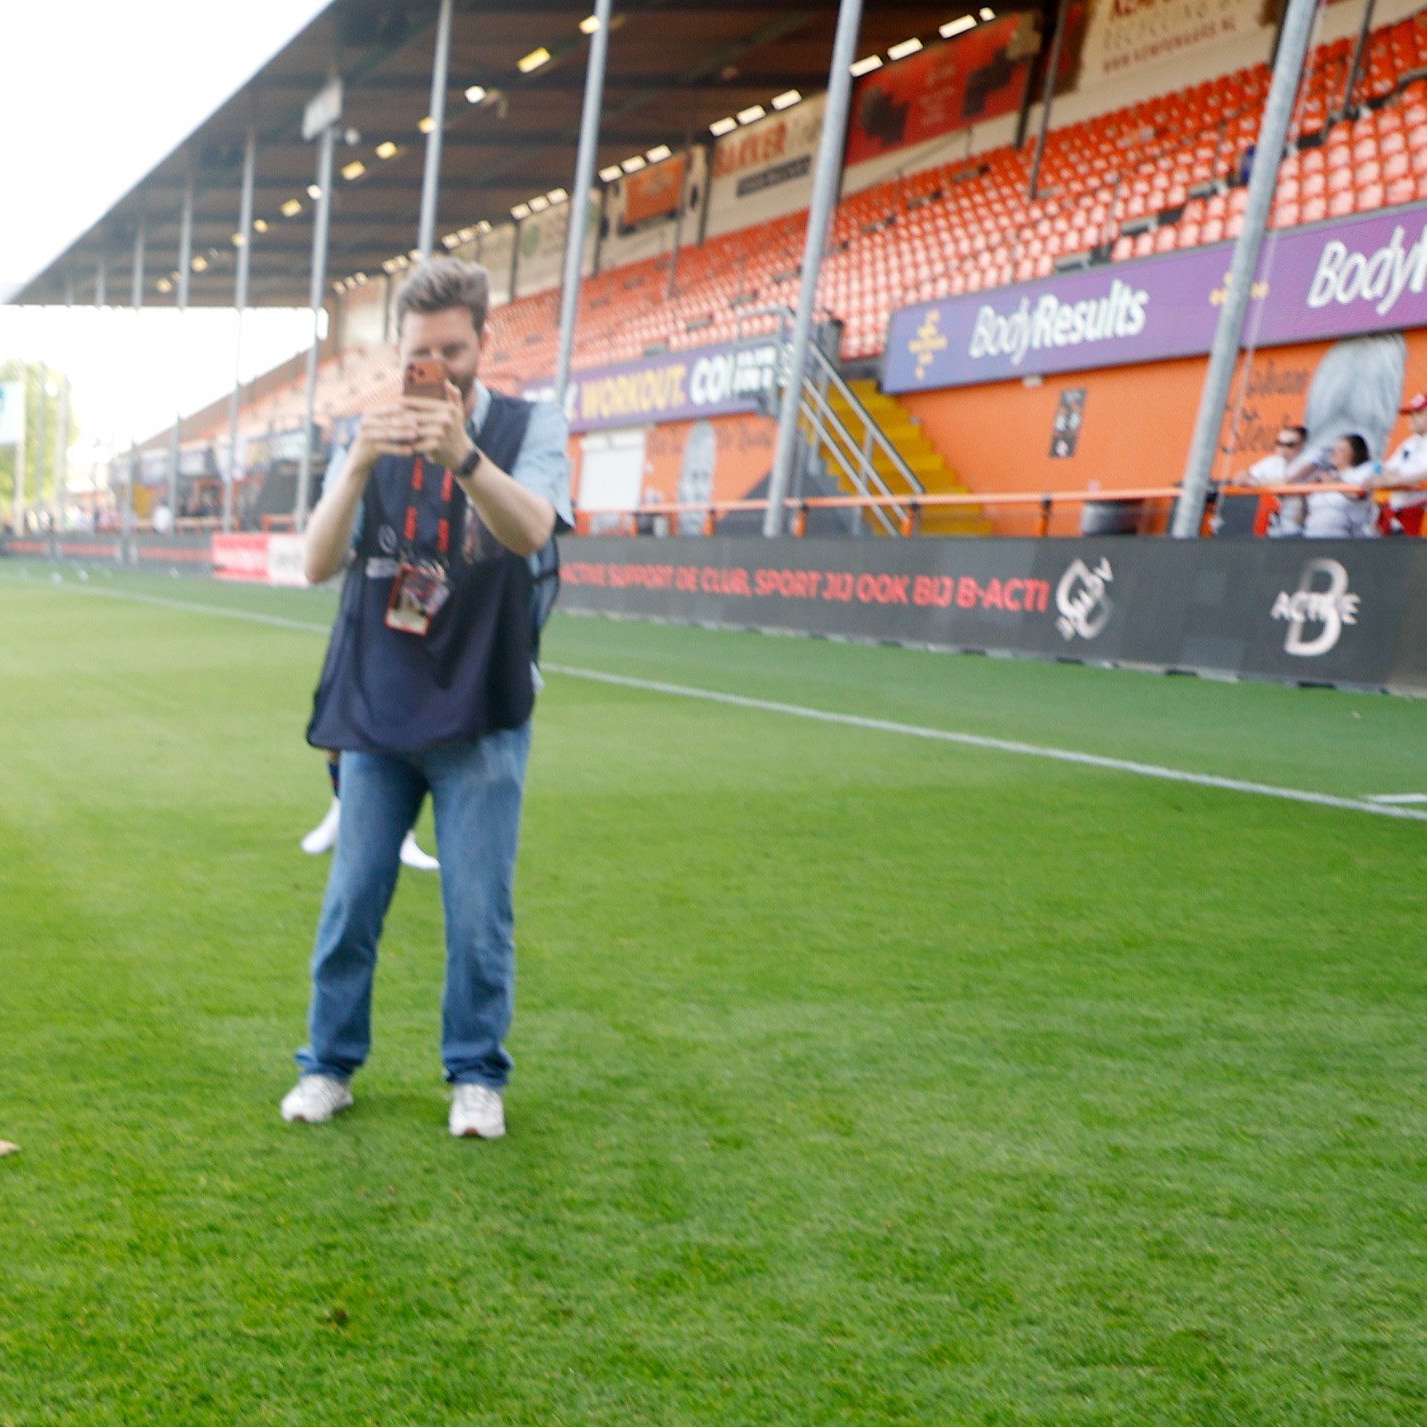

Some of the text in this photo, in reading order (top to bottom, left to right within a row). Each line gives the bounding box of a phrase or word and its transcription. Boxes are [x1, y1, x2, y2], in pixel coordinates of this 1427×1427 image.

[968, 278, 1150, 366] BodyResults
[608, 563, 674, 591] SUPPORT
[675, 565, 699, 593] DE
[753, 568, 821, 599] SPORT
[856, 572, 911, 605] OOK
[912, 574, 954, 608] BIJ
